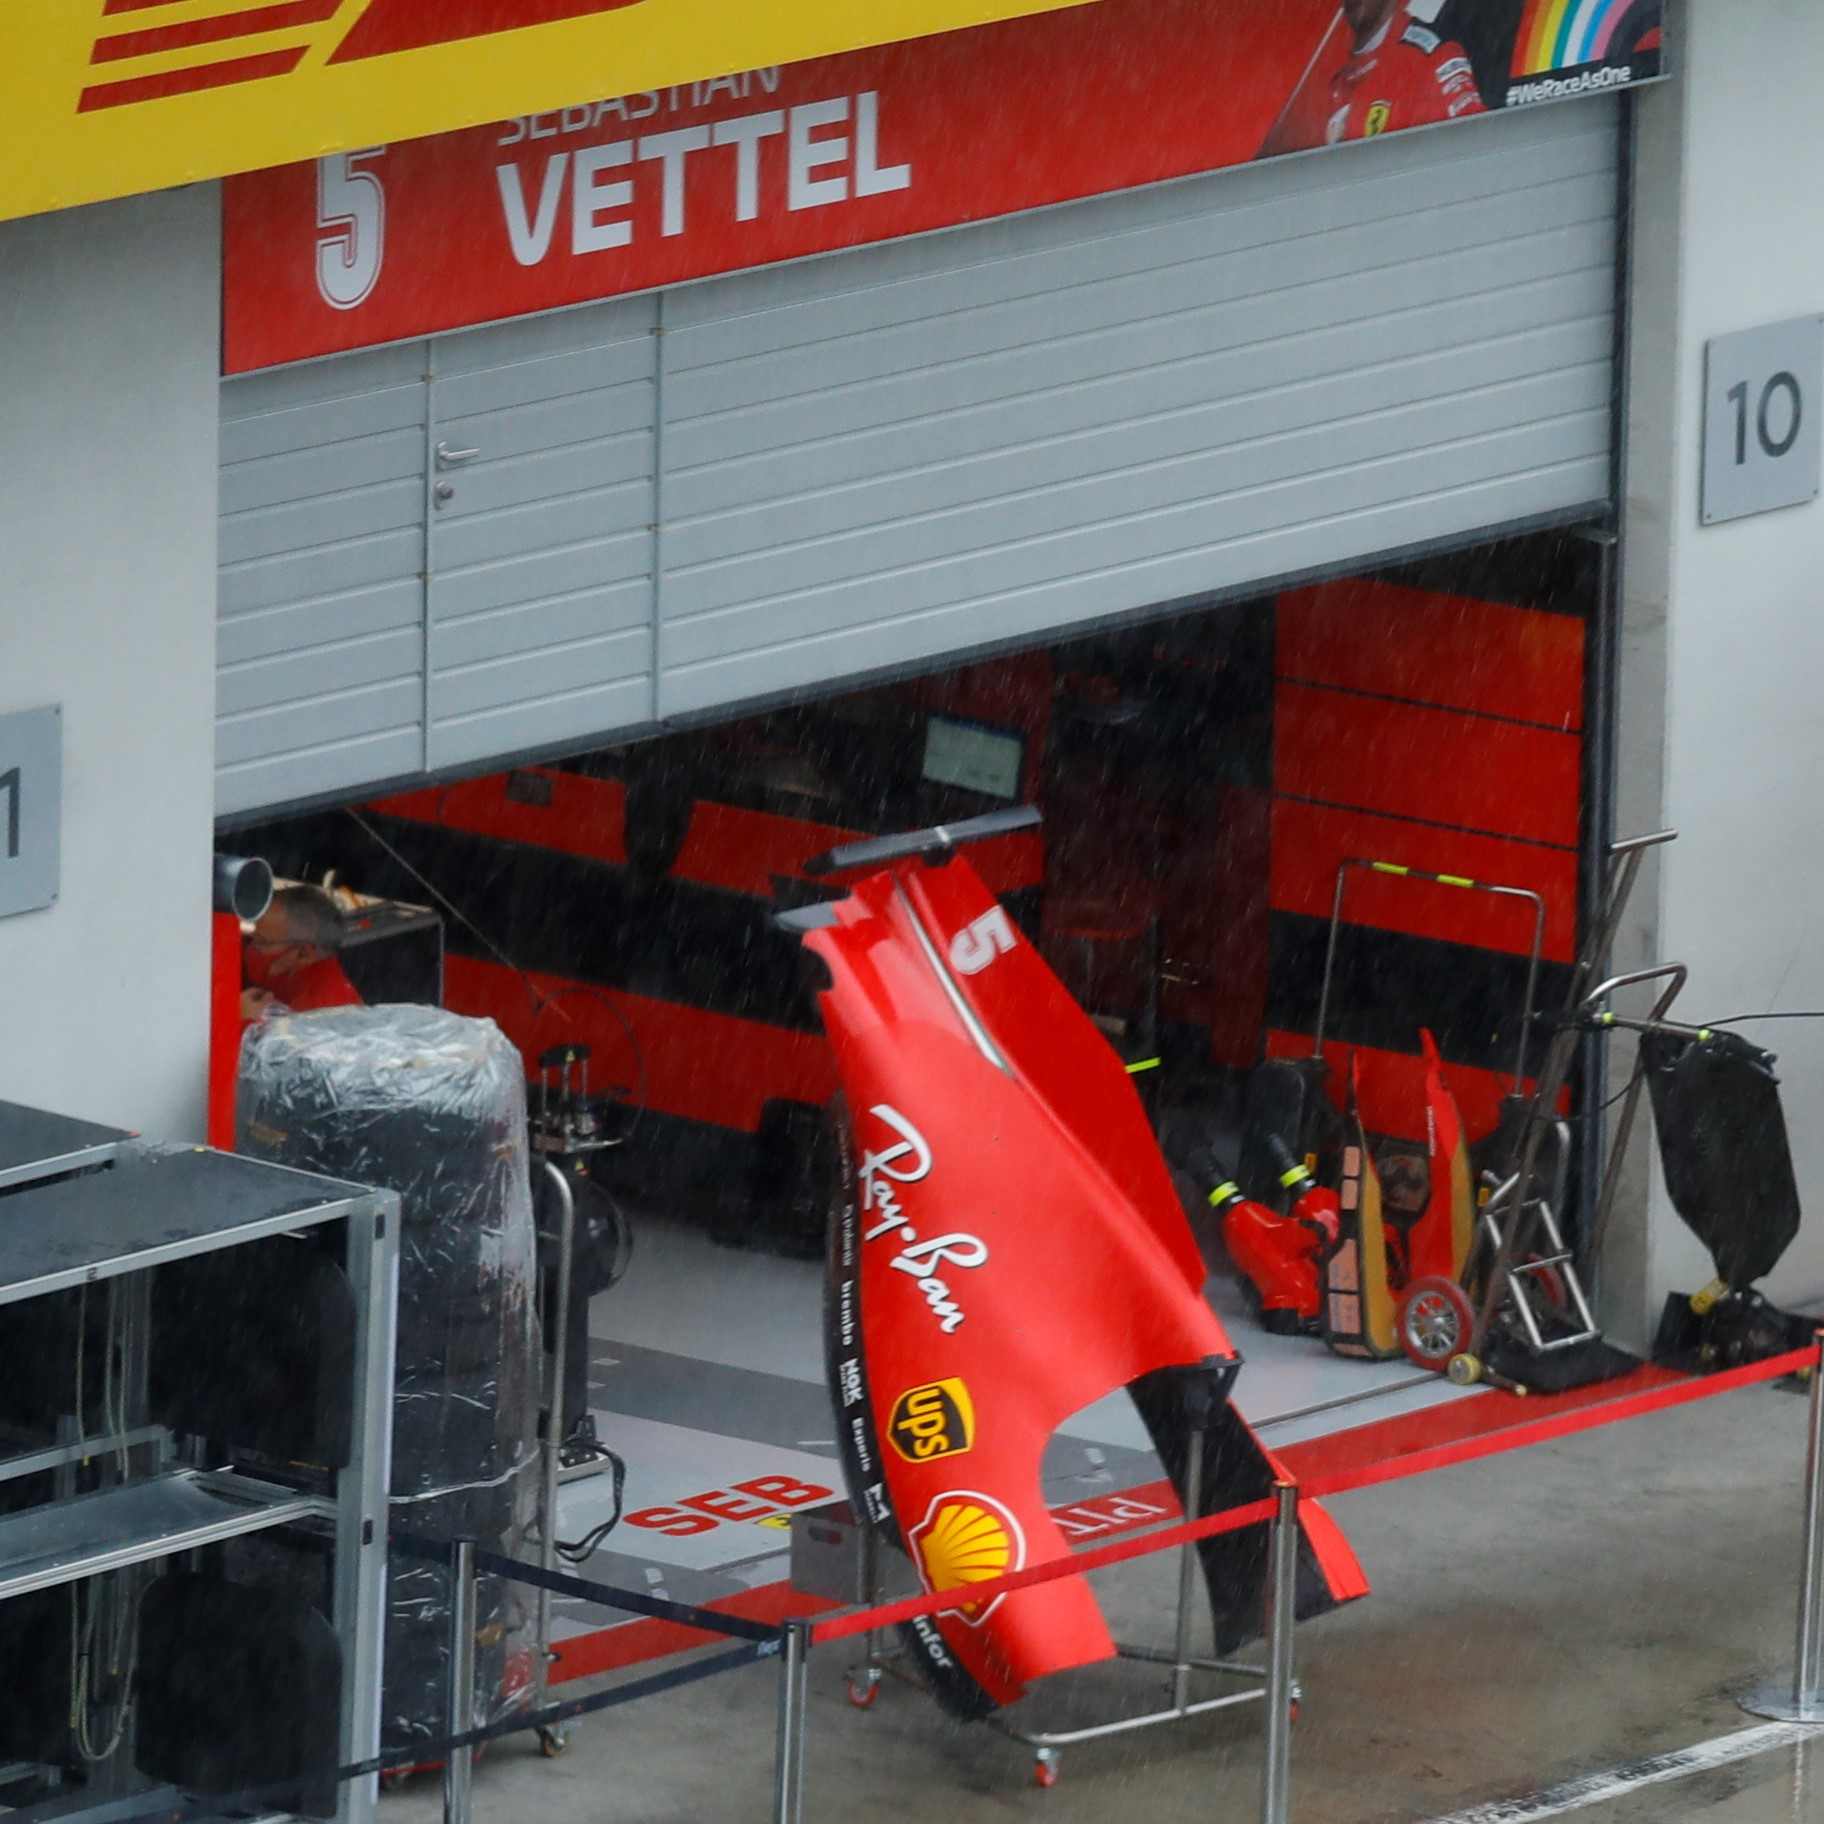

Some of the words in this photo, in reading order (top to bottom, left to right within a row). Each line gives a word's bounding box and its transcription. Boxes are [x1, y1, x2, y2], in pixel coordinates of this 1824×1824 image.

[1506, 65, 1632, 106] #WeRaceAsOne
[315, 146, 387, 311] 5
[496, 90, 911, 267] VETTEL
[1727, 370, 1801, 466] 10
[949, 905, 1017, 976] 5
[840, 1280, 856, 1346] brembo
[897, 1387, 950, 1458] ups
[626, 1475, 832, 1536] SEB
